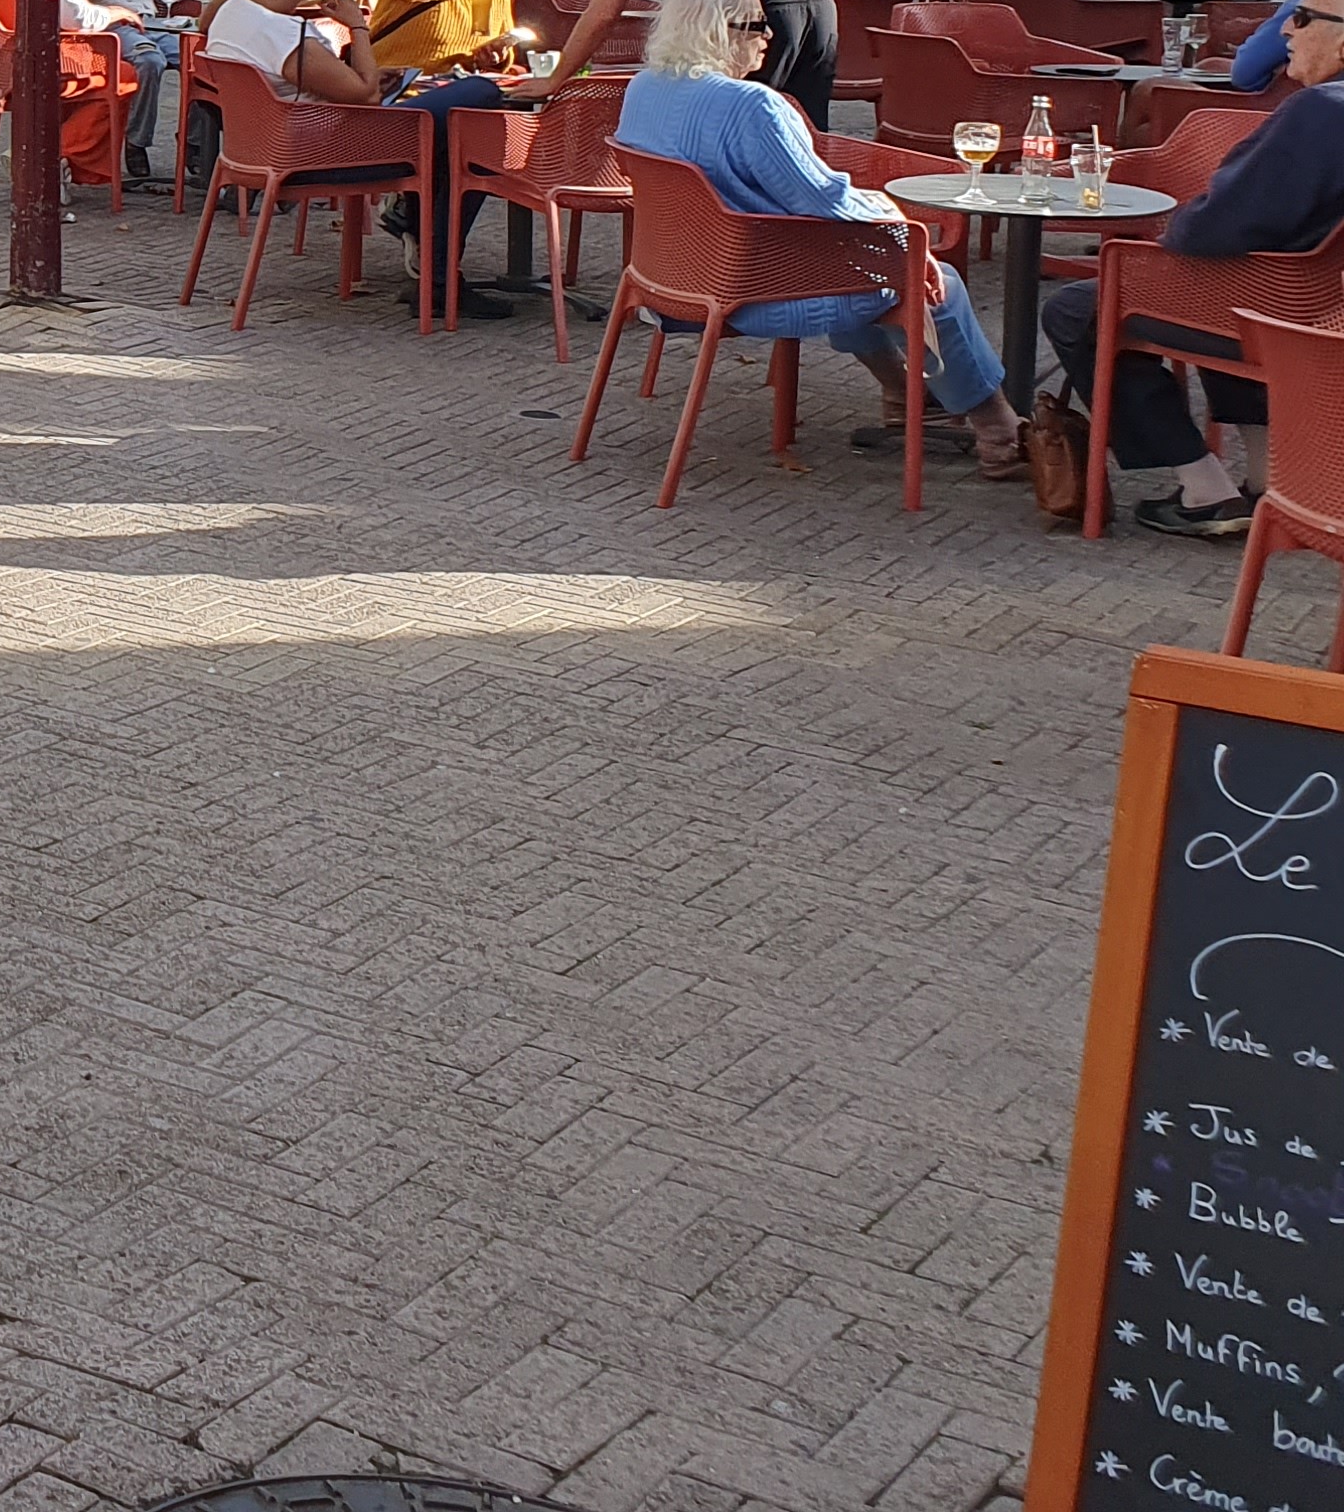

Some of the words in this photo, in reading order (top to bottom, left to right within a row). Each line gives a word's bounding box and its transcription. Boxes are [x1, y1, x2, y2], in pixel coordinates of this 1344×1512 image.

[1184, 743, 1339, 890] Le
[1205, 1008, 1274, 1058] Vente
[1293, 1045, 1338, 1071] de
[1187, 1102, 1259, 1147] Jus
[1285, 1135, 1319, 1160] de
[1188, 1181, 1307, 1243] Bubble
[1174, 1251, 1267, 1308] Vente
[1286, 1294, 1329, 1326] de
[1148, 1377, 1234, 1433] Vente
[1150, 1454, 1250, 1512] Crème
